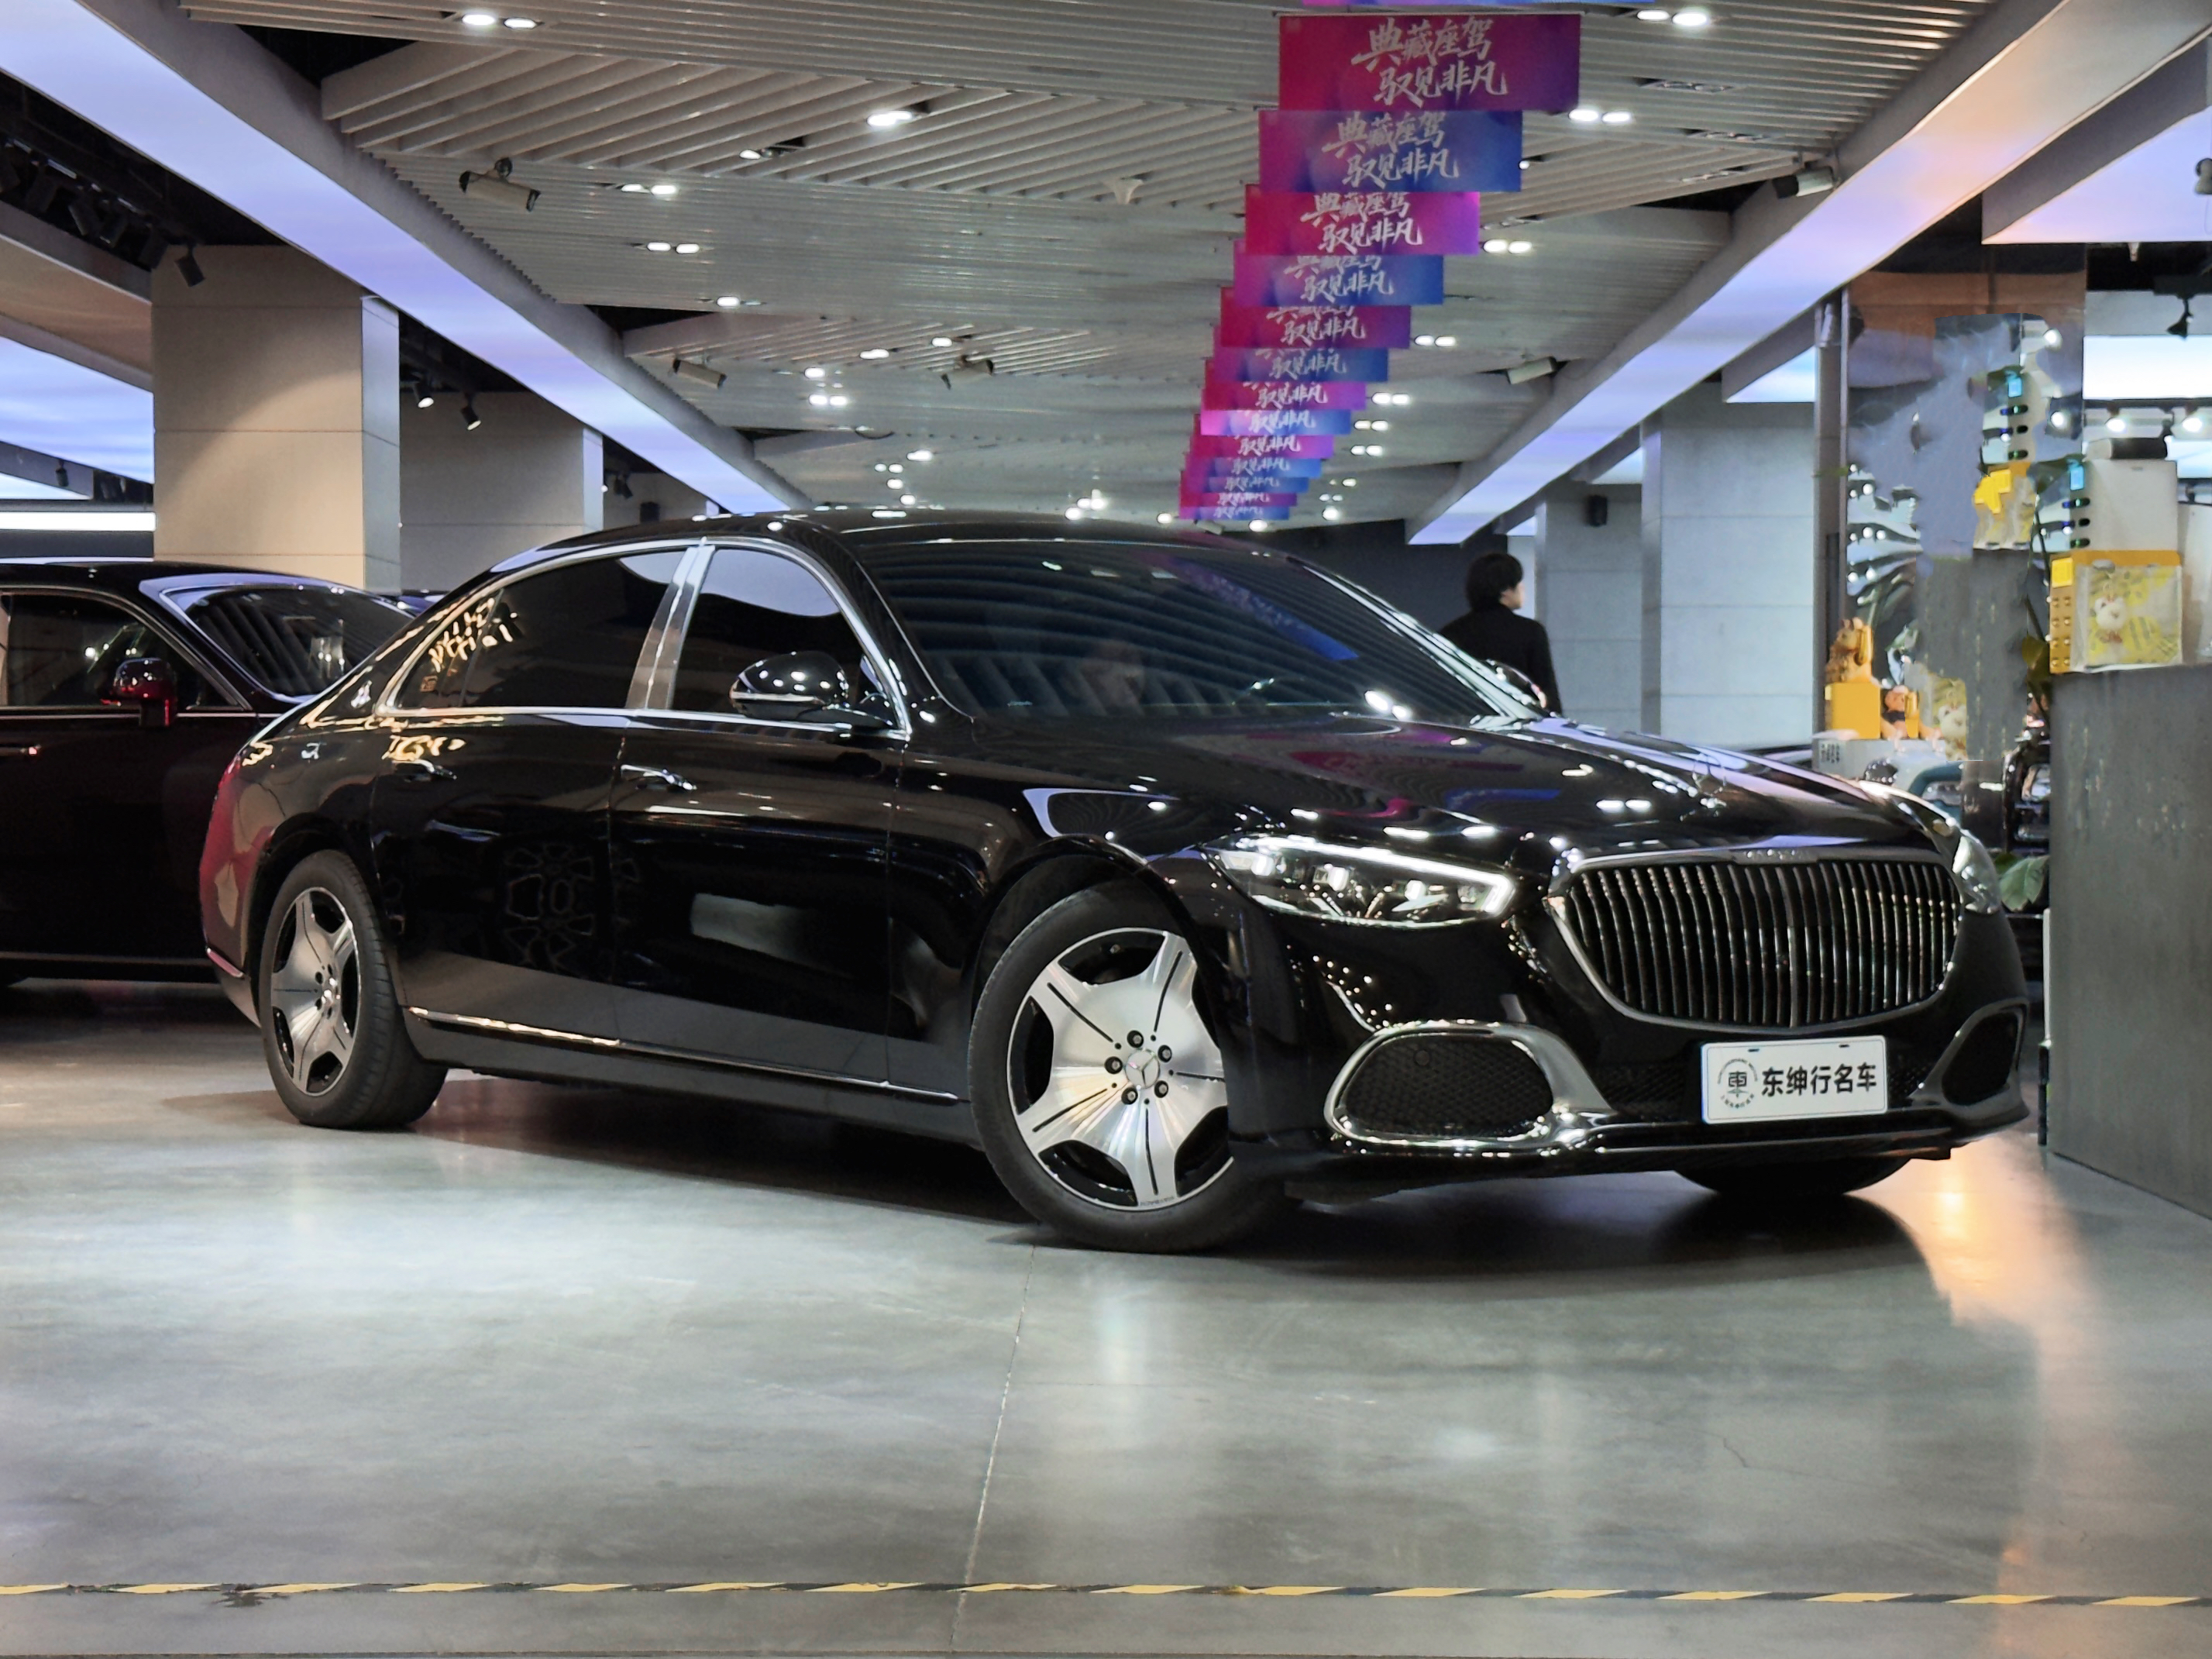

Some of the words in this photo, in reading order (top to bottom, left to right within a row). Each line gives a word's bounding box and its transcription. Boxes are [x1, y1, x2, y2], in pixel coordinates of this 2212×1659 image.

[1351, 18, 1492, 72] 典藏座驾
[1373, 60, 1508, 108] 驭见非凡
[1322, 111, 1447, 159] 典藏座驾
[1341, 148, 1459, 189] 驭见非凡
[1318, 218, 1422, 254] 驭见非凡
[1762, 1062, 1877, 1097] 东绅行名车
